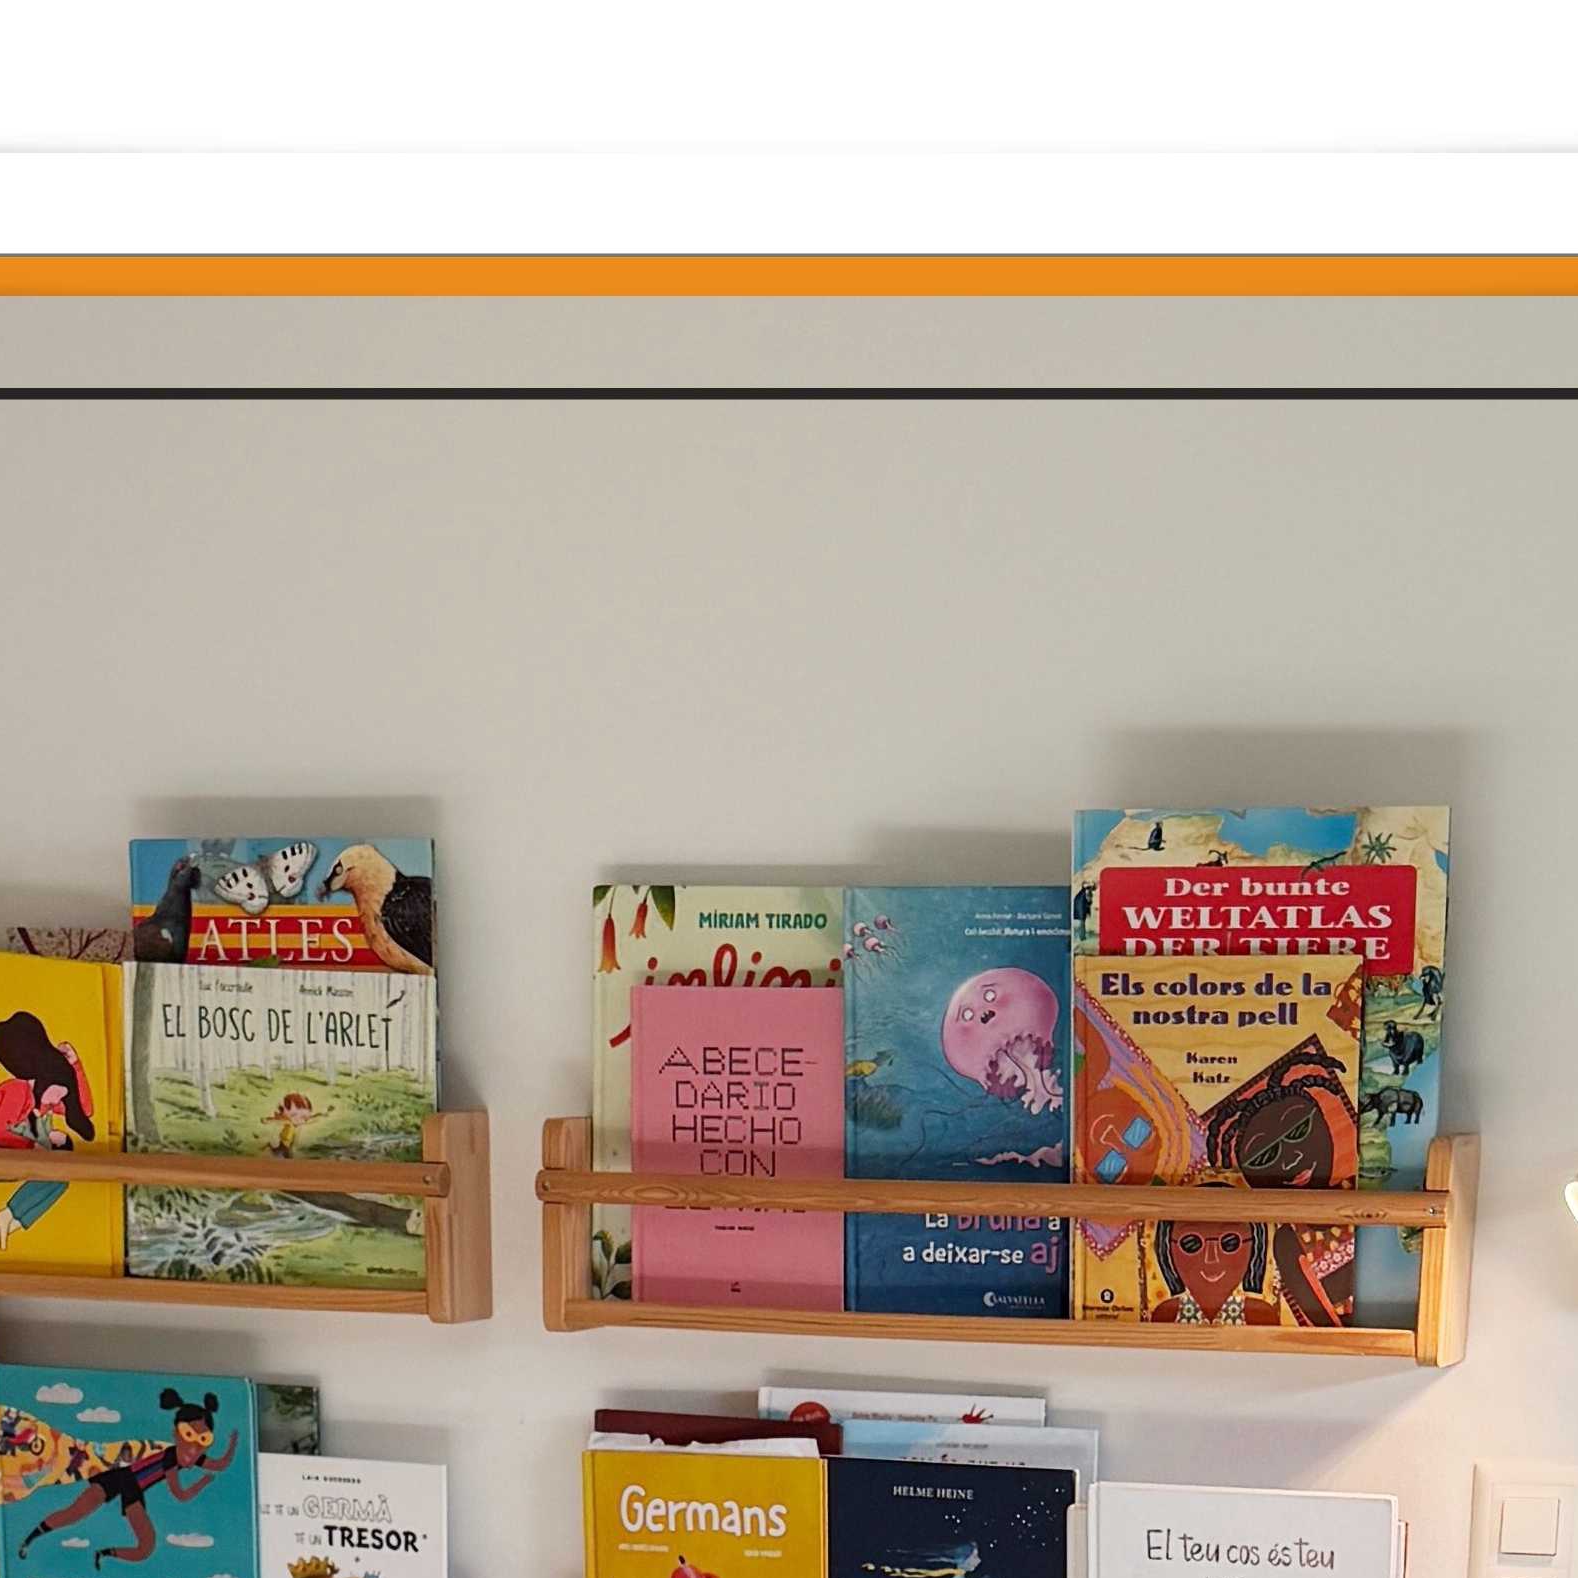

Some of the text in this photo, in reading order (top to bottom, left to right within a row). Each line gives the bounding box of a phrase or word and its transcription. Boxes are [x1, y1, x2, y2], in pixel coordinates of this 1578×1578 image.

[1164, 876, 1350, 897] Der bunte
[699, 909, 827, 930] MÍRIAM TIRADO
[1122, 904, 1393, 931] WELTATLAS
[197, 917, 355, 963] ATLES
[1100, 972, 1332, 996] Els colors de la
[162, 1003, 186, 1038] EL
[198, 1005, 255, 1042] BOSC
[268, 1008, 294, 1044] DE
[1133, 1002, 1299, 1028] nostra pell
[1186, 1051, 1238, 1064] Karen
[1192, 1071, 1230, 1084] Katz
[675, 1080, 796, 1110] DARIO
[672, 1115, 802, 1145] HECHO
[700, 1149, 775, 1178] CON
[902, 1244, 916, 1262] a
[922, 1241, 1024, 1265] deixar-se
[893, 1484, 974, 1500] HELME HEINE
[302, 1494, 392, 1524] GERMÀ
[619, 1483, 787, 1538] Germans
[323, 1525, 419, 1552] TRESOR
[1147, 1528, 1335, 1570] El teu cos és teu
